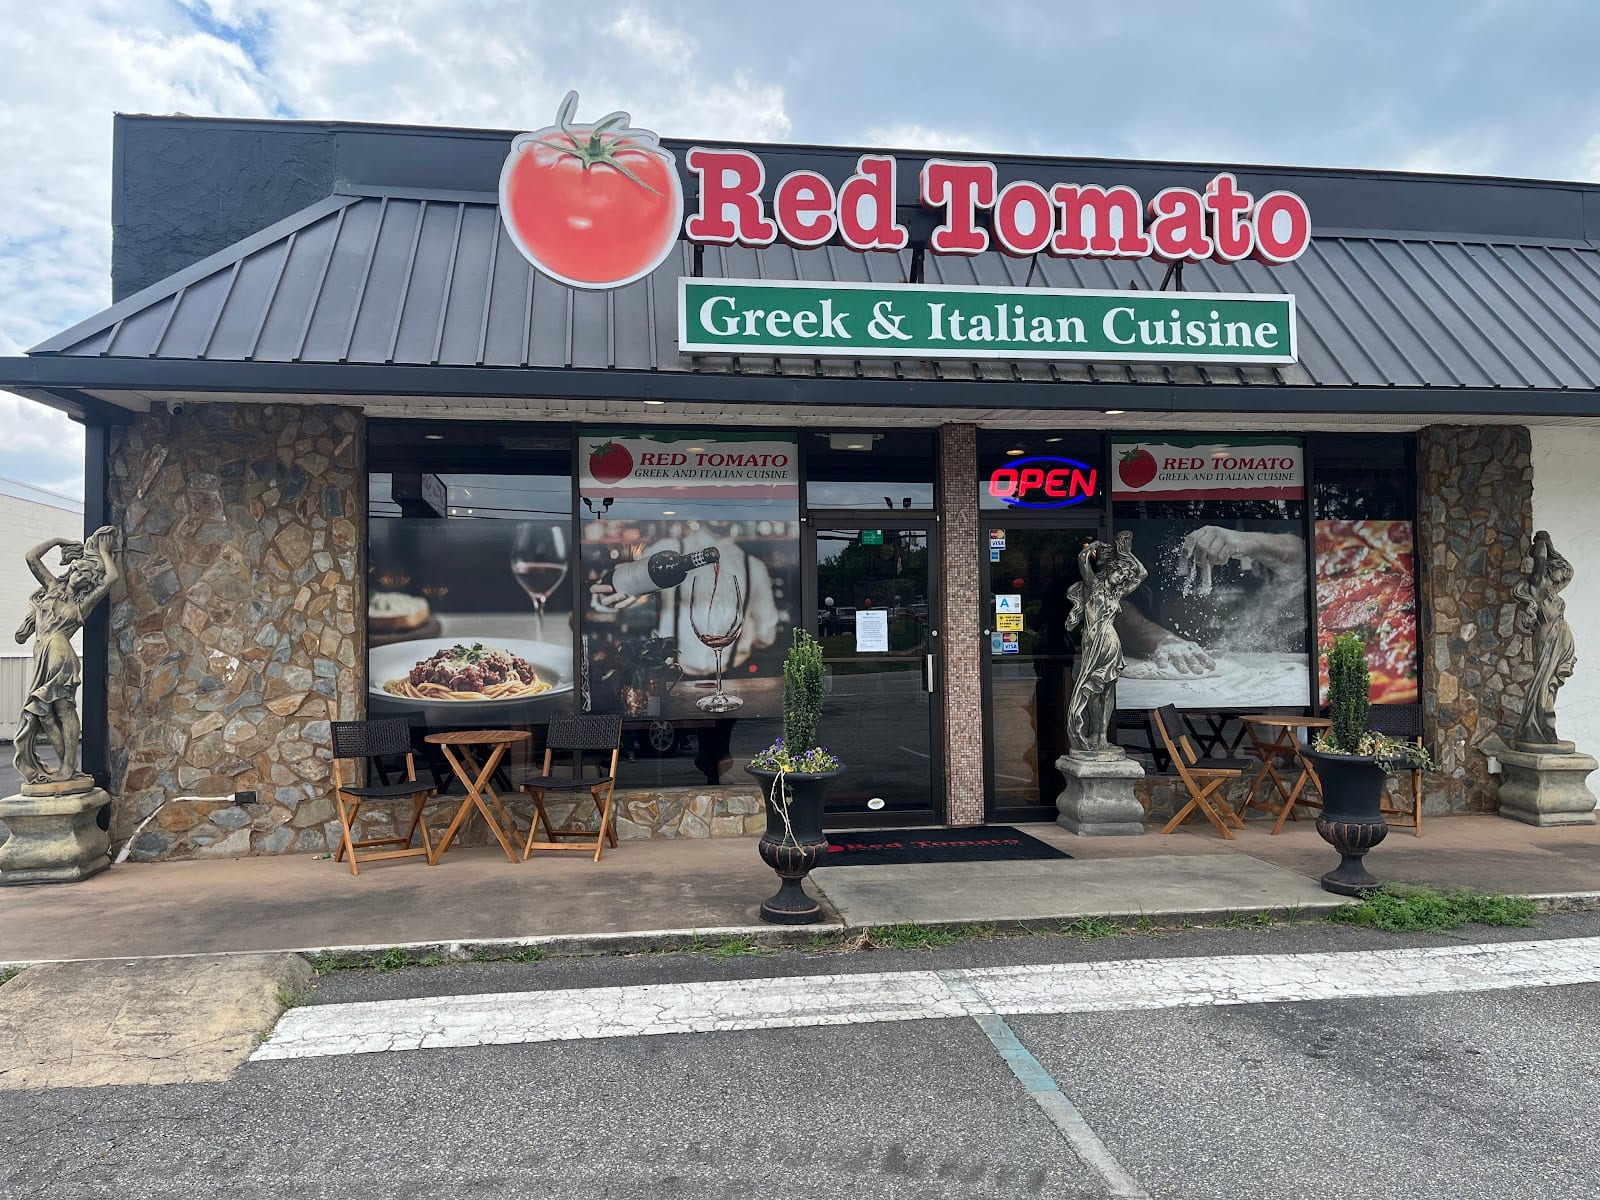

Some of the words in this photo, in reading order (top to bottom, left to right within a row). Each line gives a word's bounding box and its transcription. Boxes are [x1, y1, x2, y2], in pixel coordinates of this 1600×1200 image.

[685, 147, 908, 250] Red
[920, 158, 1312, 266] Tomato
[700, 295, 851, 341] Greek
[867, 302, 912, 340] &
[928, 303, 1087, 343] Italian
[1102, 305, 1279, 349] Cuisine
[640, 453, 687, 466] RED
[695, 453, 788, 467] TOMATO
[1163, 457, 1205, 470] RED
[1211, 457, 1294, 470] TOMATO
[634, 468, 670, 478] GREEK
[672, 469, 697, 478] AND
[699, 470, 743, 479] ITALIAN
[746, 470, 789, 479] CUISINE
[1158, 473, 1190, 482] GREEK
[1192, 473, 1214, 481] AND
[1215, 473, 1255, 481] ITALIAN
[1257, 473, 1294, 481] CUISINE
[988, 468, 1097, 497] OPEN
[1000, 598, 1010, 608] A
[910, 839, 1020, 848] Tomato
